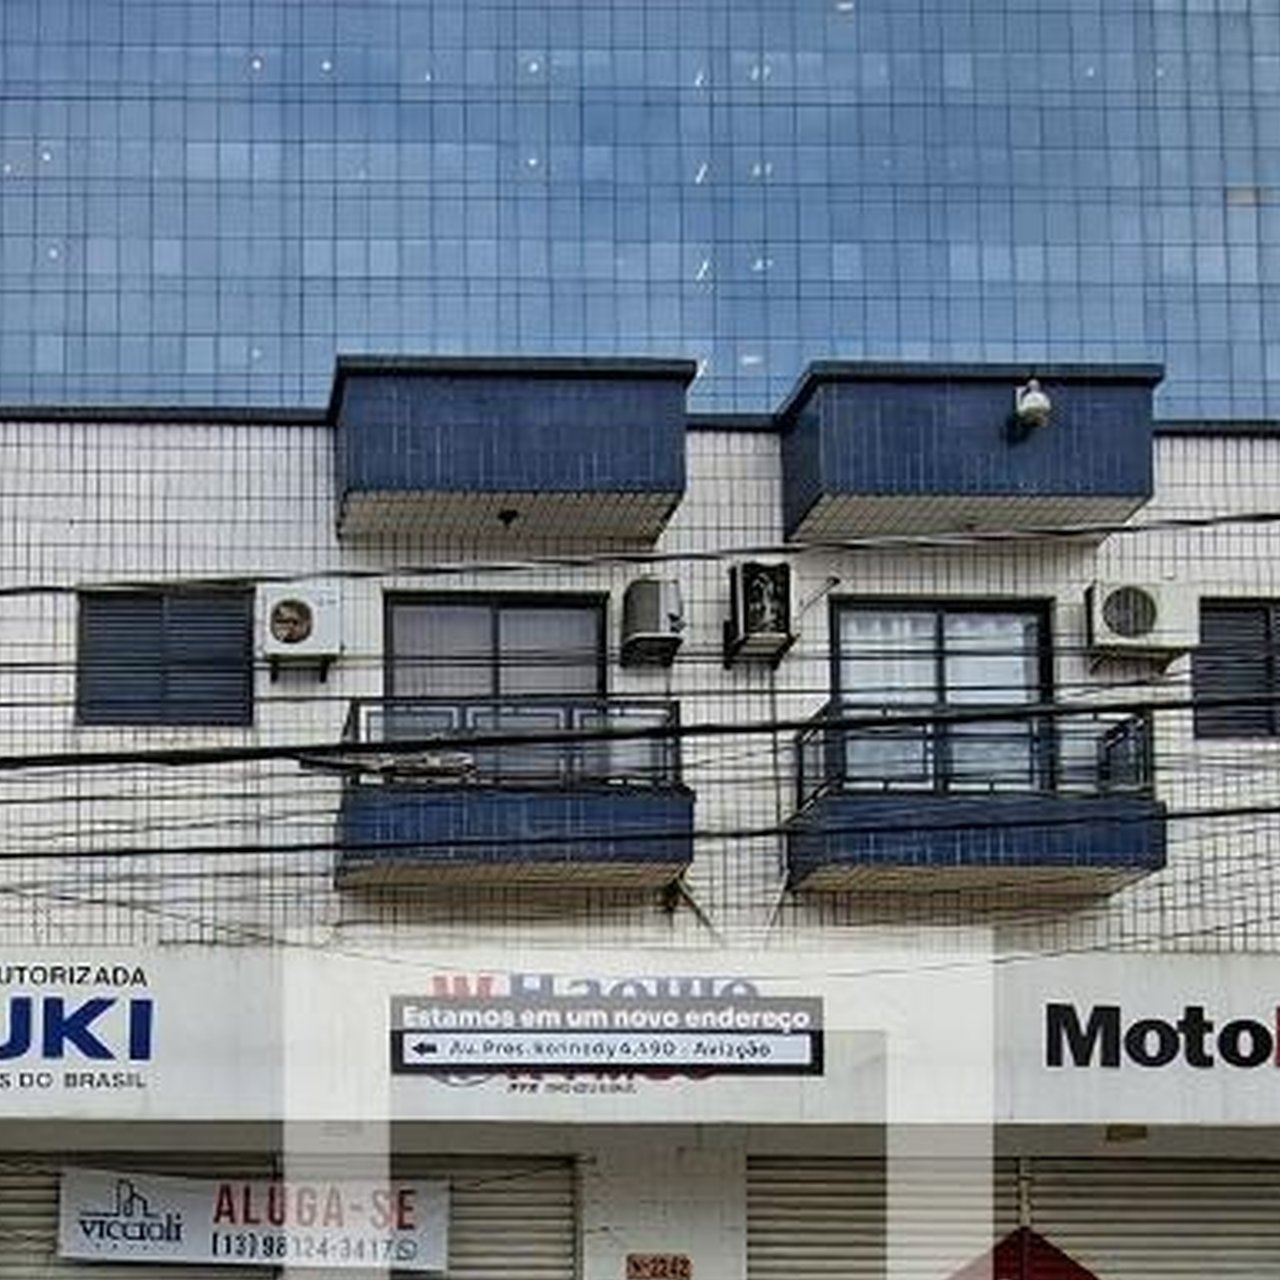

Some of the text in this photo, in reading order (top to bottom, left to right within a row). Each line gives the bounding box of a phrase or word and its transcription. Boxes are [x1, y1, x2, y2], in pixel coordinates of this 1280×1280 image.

[403, 1006, 811, 1034] Estamos em um novo endereço
[20, 1072, 52, 1088] DO
[64, 1072, 147, 1088] BRASIL
[213, 1183, 418, 1231] ALUGA-SE
[211, 1231, 260, 1258] (13)
